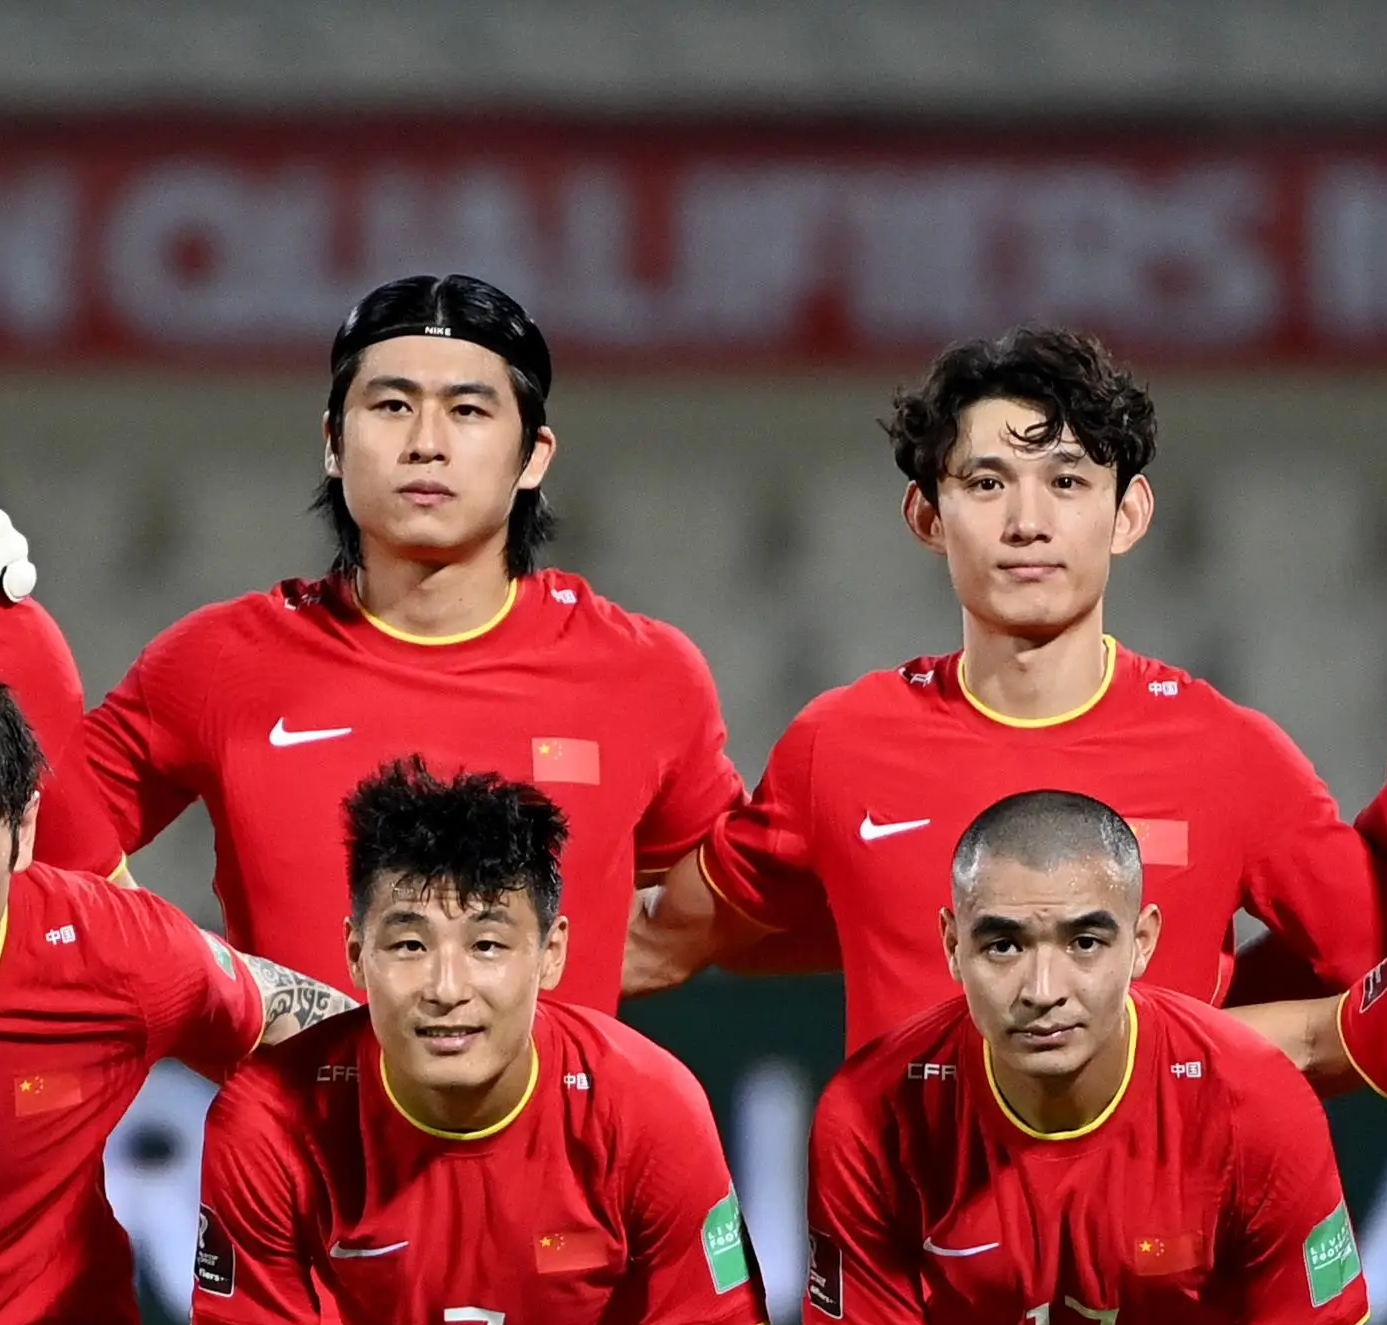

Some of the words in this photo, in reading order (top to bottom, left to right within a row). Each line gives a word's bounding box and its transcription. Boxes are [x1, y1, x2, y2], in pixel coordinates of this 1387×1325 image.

[424, 325, 452, 337] NIKE
[45, 924, 76, 945] 中国
[1170, 1061, 1202, 1079] 中国
